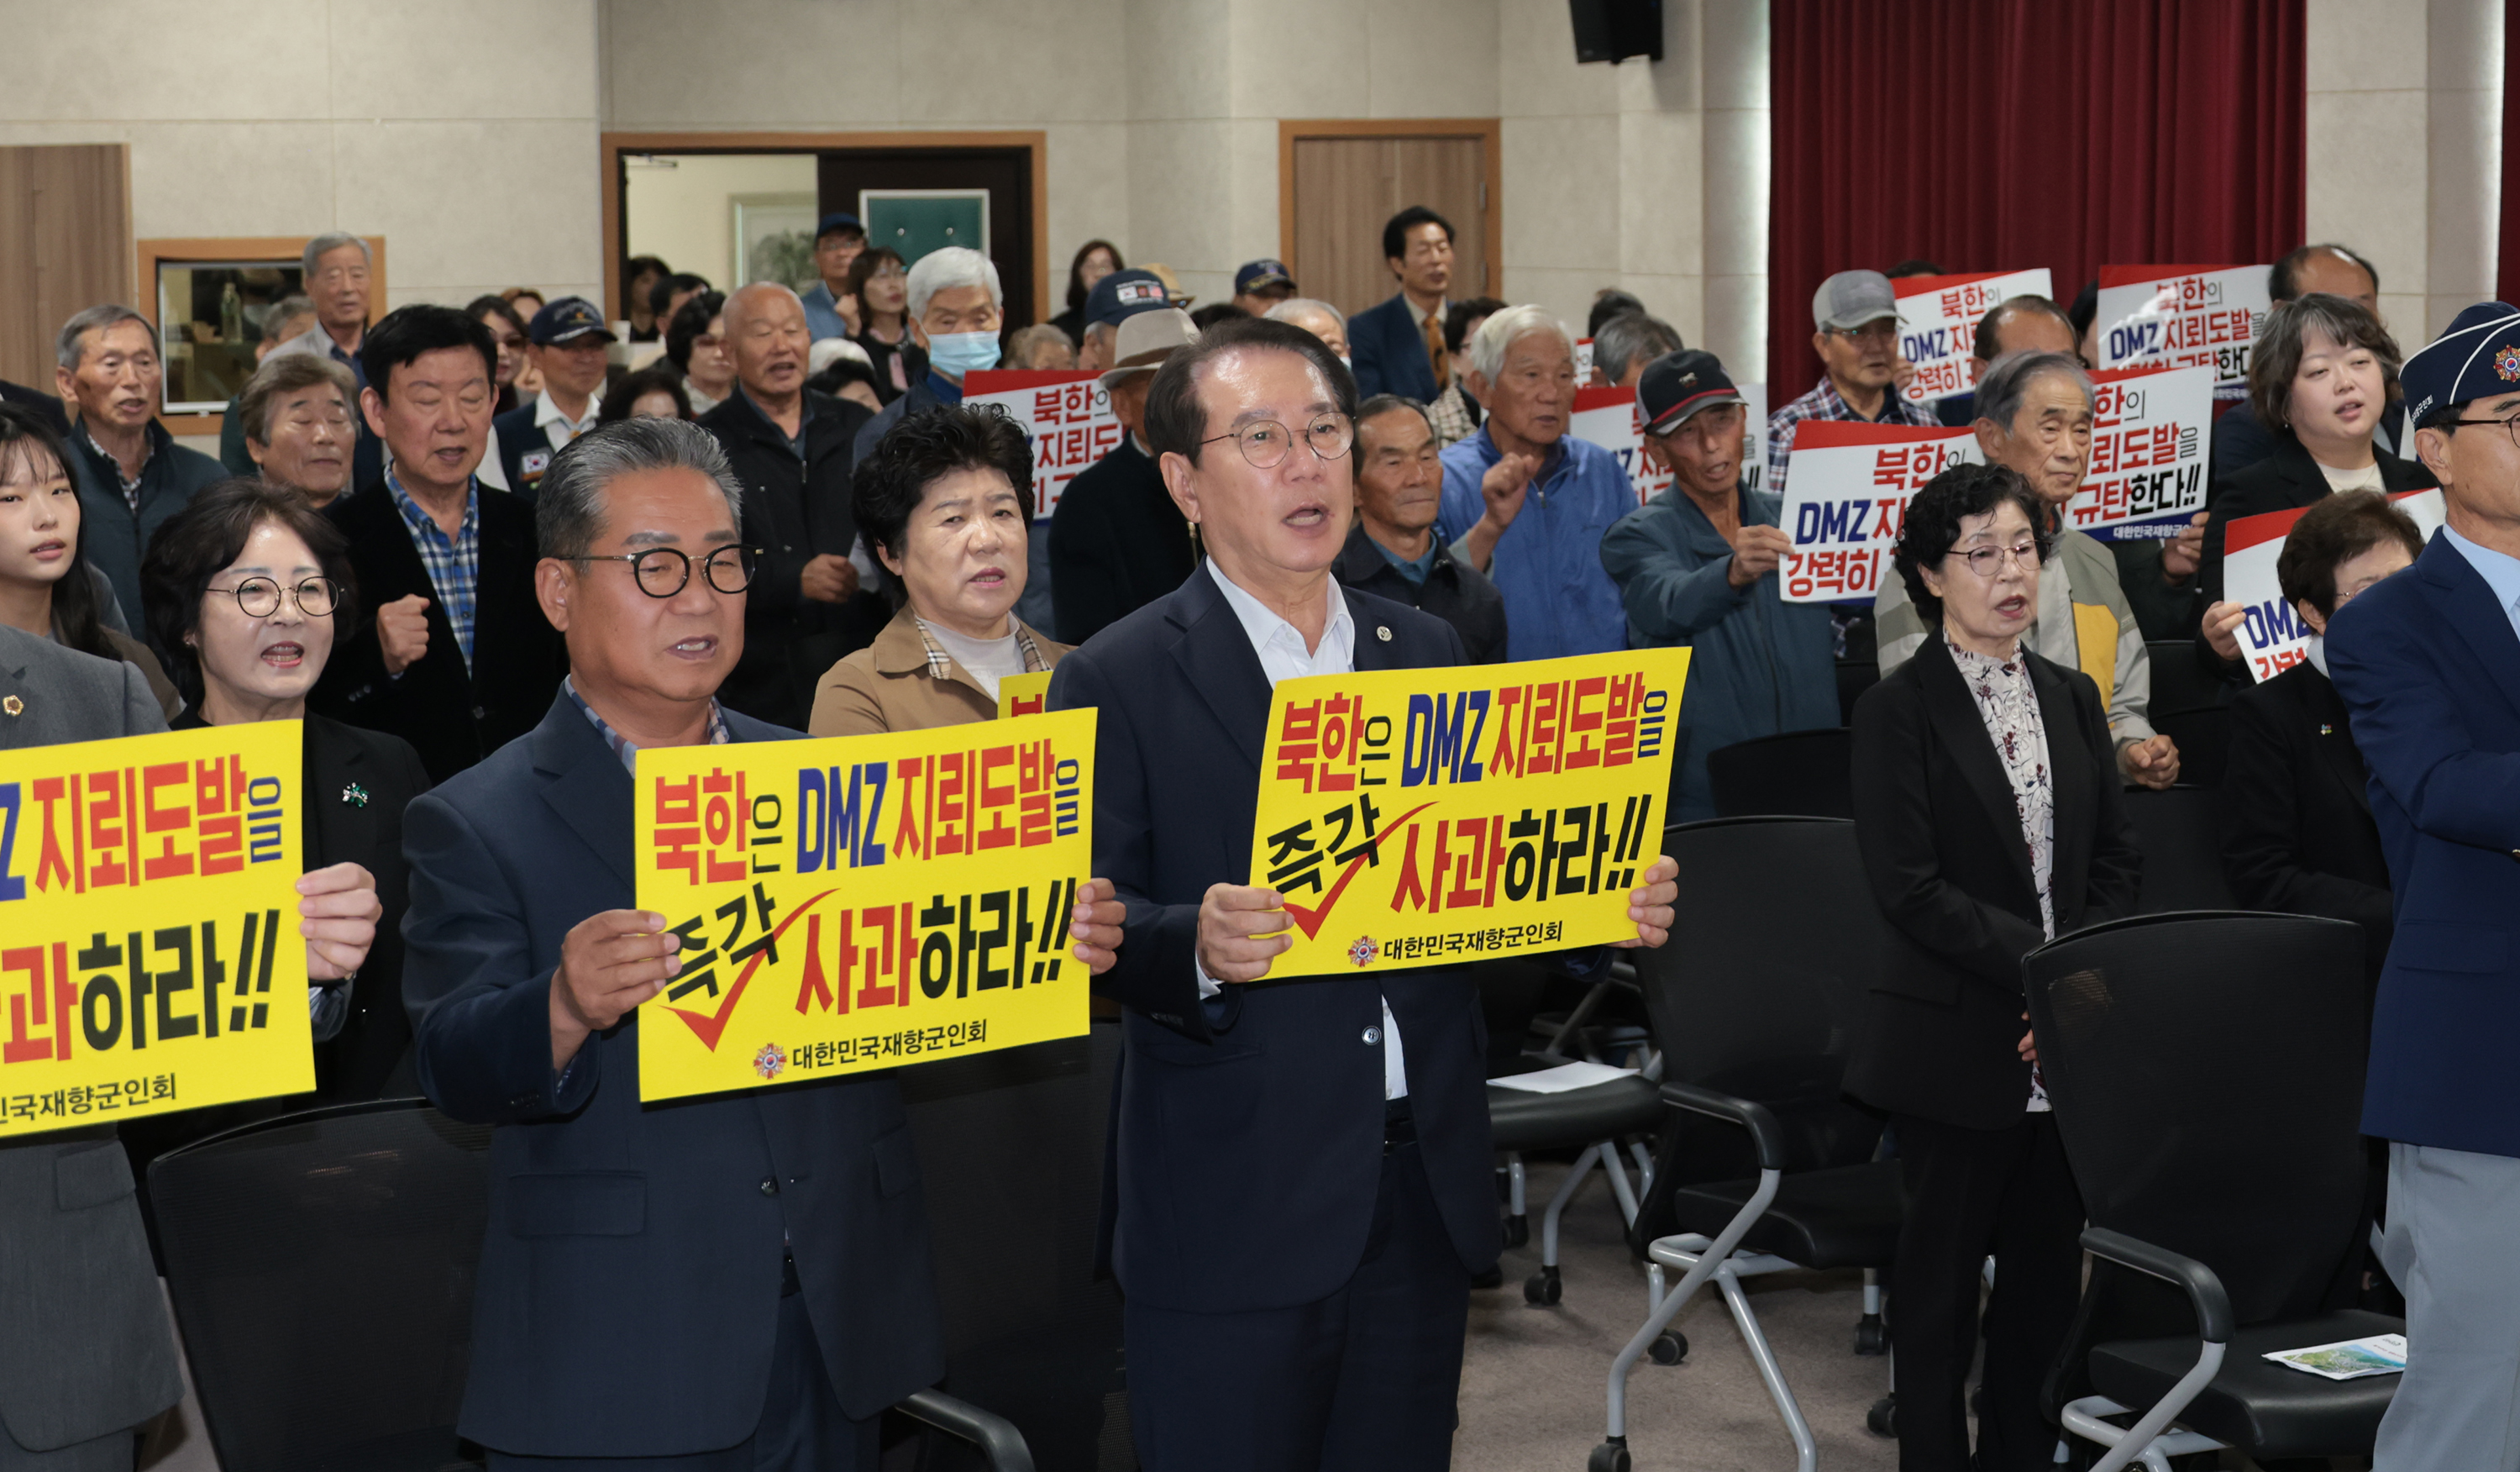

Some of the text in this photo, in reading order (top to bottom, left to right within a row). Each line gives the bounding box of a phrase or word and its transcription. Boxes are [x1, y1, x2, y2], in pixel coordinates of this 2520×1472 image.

[1903, 327, 1949, 363] DMZ
[2110, 321, 2160, 360] DMZ
[2093, 385, 2146, 429] 한의
[1037, 423, 1120, 469] 지뢰도
[2084, 422, 2198, 477] 뢰도발을
[2073, 463, 2202, 525] 규탄한다!!
[1795, 499, 1872, 545] DMZ
[1788, 548, 1880, 597] 강력히
[1276, 671, 1668, 794] 북한은 DMZ 지뢰도발을
[32, 753, 284, 896] 지뢰도발을
[654, 738, 1080, 886] 북한은 DMZ 지뢰도발을
[1266, 792, 1652, 915] 즉각 사과하라!!
[664, 877, 1077, 1017] 즉각 사과하라!!
[1383, 920, 1564, 961] 대한민국재향군인회
[0, 908, 281, 1065] 과하라!!
[792, 1018, 989, 1070] 대한민국재향군인회
[0, 1072, 177, 1124] 국재향군인회
